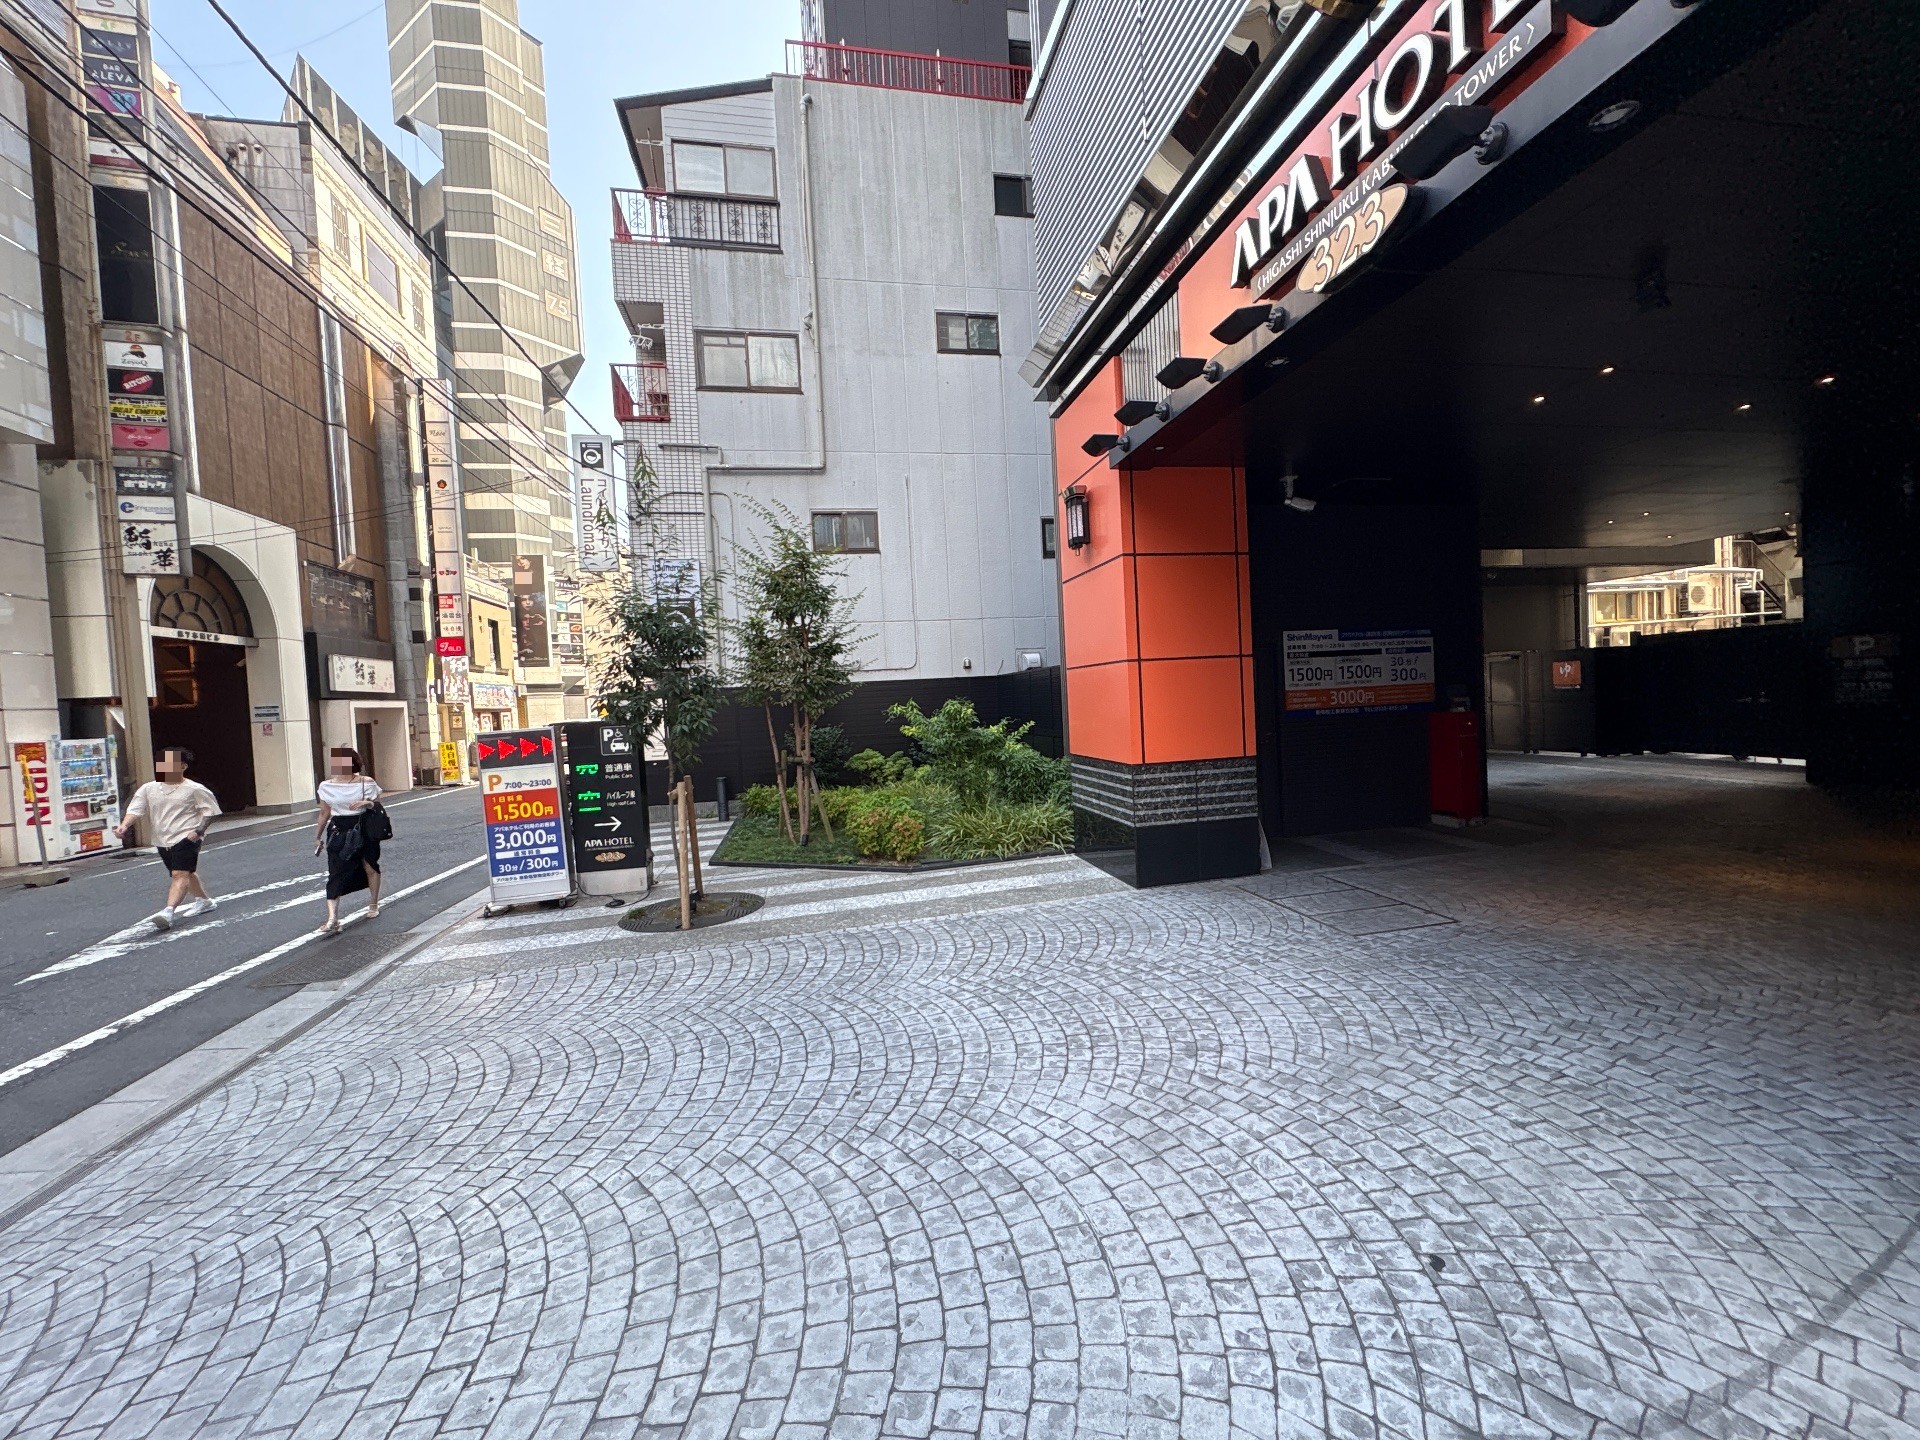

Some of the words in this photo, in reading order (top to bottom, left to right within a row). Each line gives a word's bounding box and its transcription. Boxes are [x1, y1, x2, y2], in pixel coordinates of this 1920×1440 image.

[1455, 35, 1522, 106] TOWER
[1231, 153, 1320, 288] APA
[1304, 190, 1359, 251] SHINJUKU
[1313, 191, 1385, 293] 323
[580, 478, 599, 557] Laundromat
[1287, 633, 1333, 642] ShinMaywa
[1288, 667, 1333, 682] 1500円
[1338, 665, 1382, 680] 1500円
[1330, 690, 1375, 706] 3000円
[603, 729, 614, 742] P
[605, 763, 633, 773] 普通車
[488, 774, 503, 792] P
[493, 801, 554, 822] 1,500円
[494, 829, 556, 850] 3,000円
[585, 839, 603, 848] APA
[604, 837, 635, 846] HOTEL
